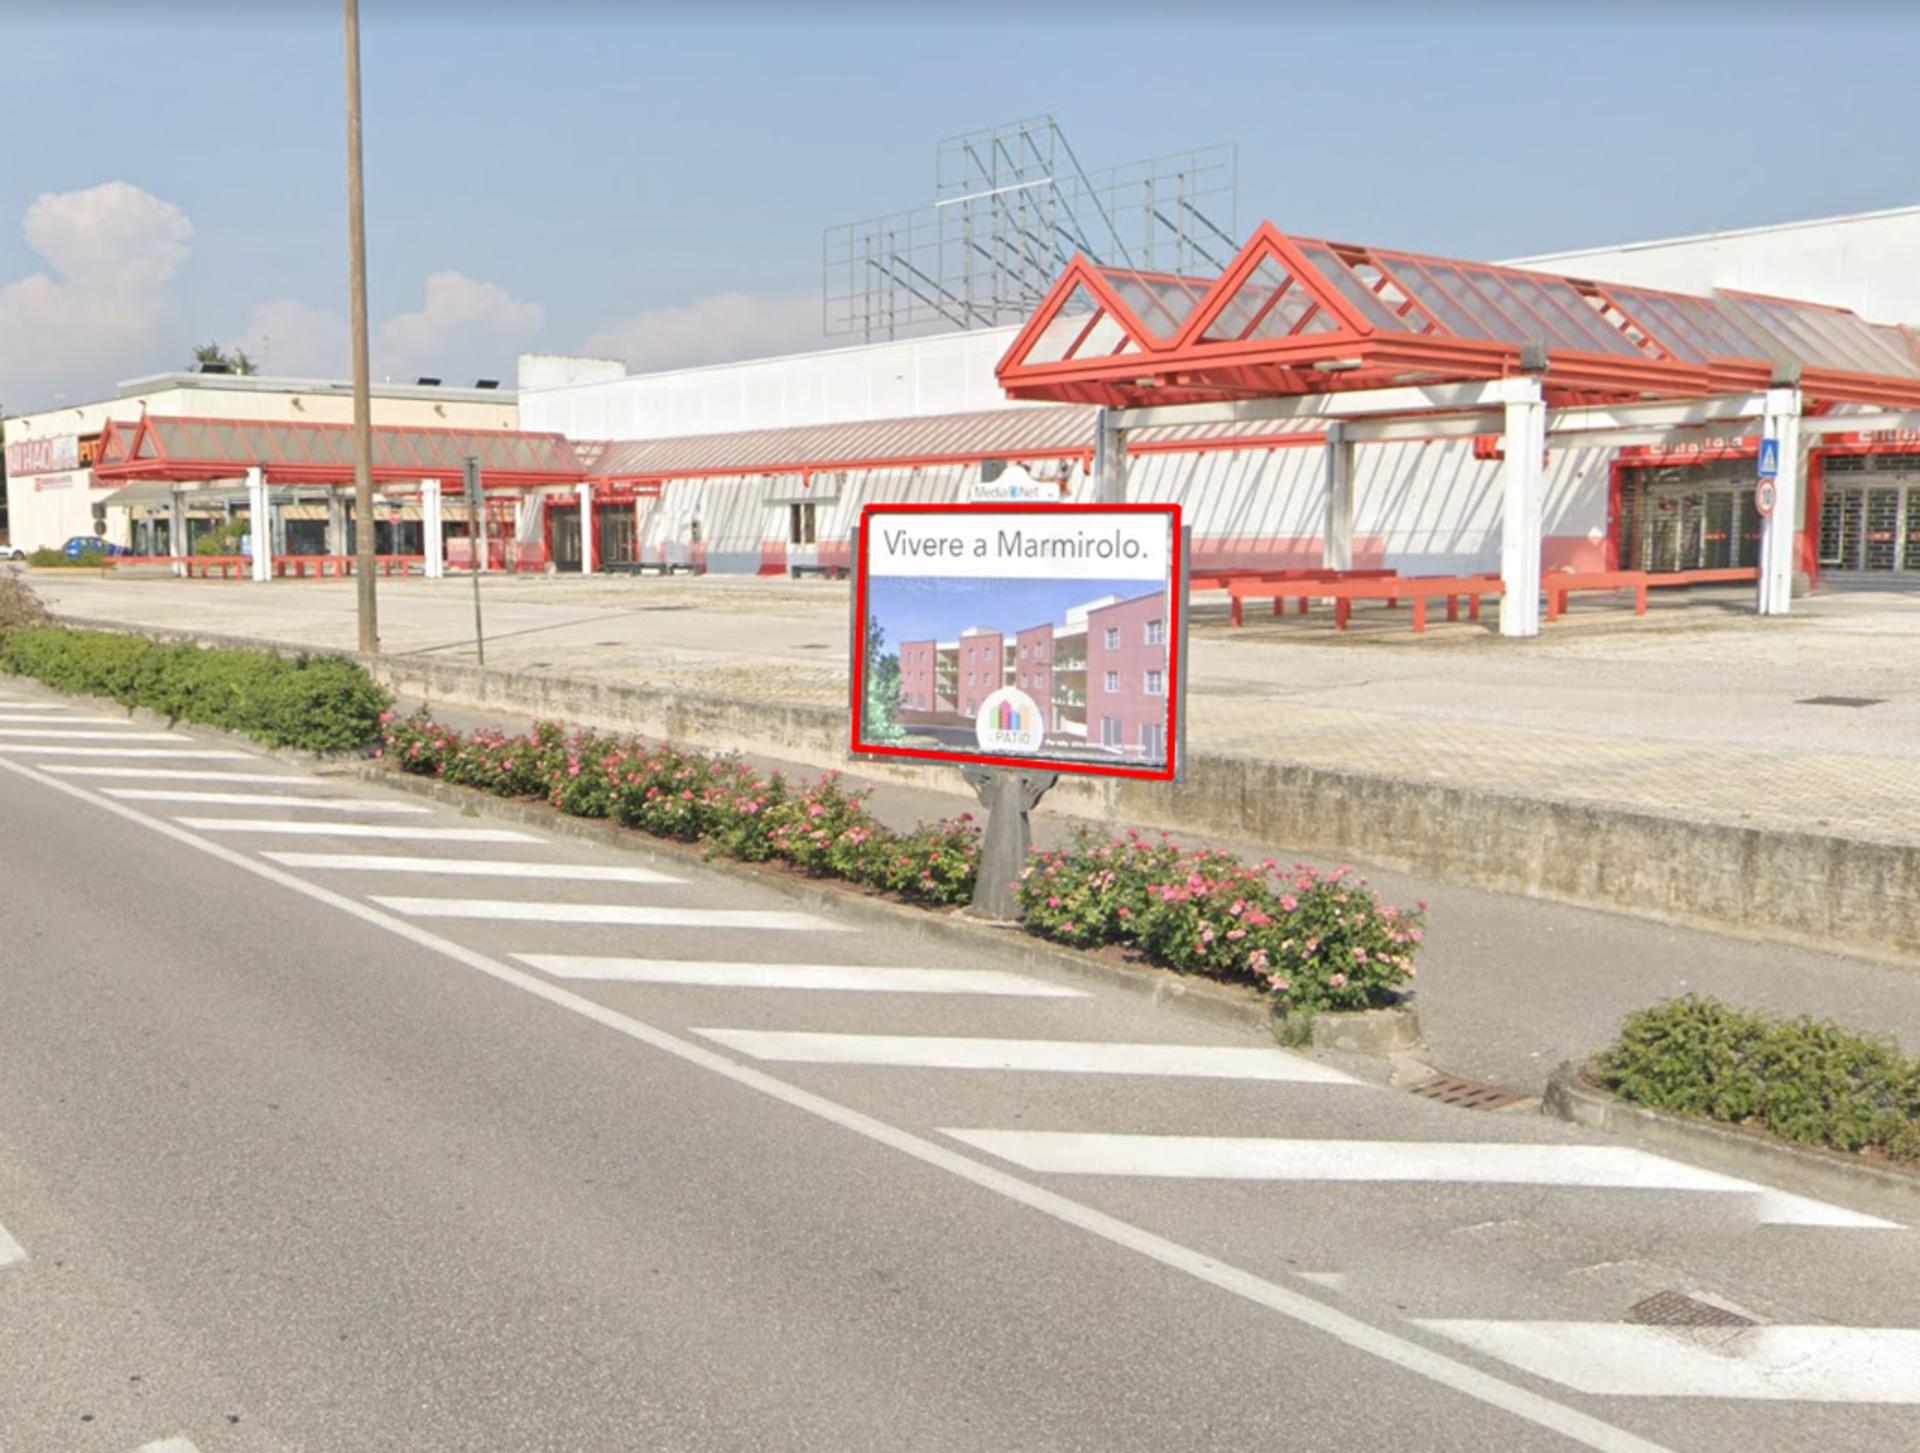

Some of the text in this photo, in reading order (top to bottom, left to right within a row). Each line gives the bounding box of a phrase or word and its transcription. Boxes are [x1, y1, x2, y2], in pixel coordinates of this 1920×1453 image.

[883, 529, 1149, 559] Vivere a Marmirolo.
